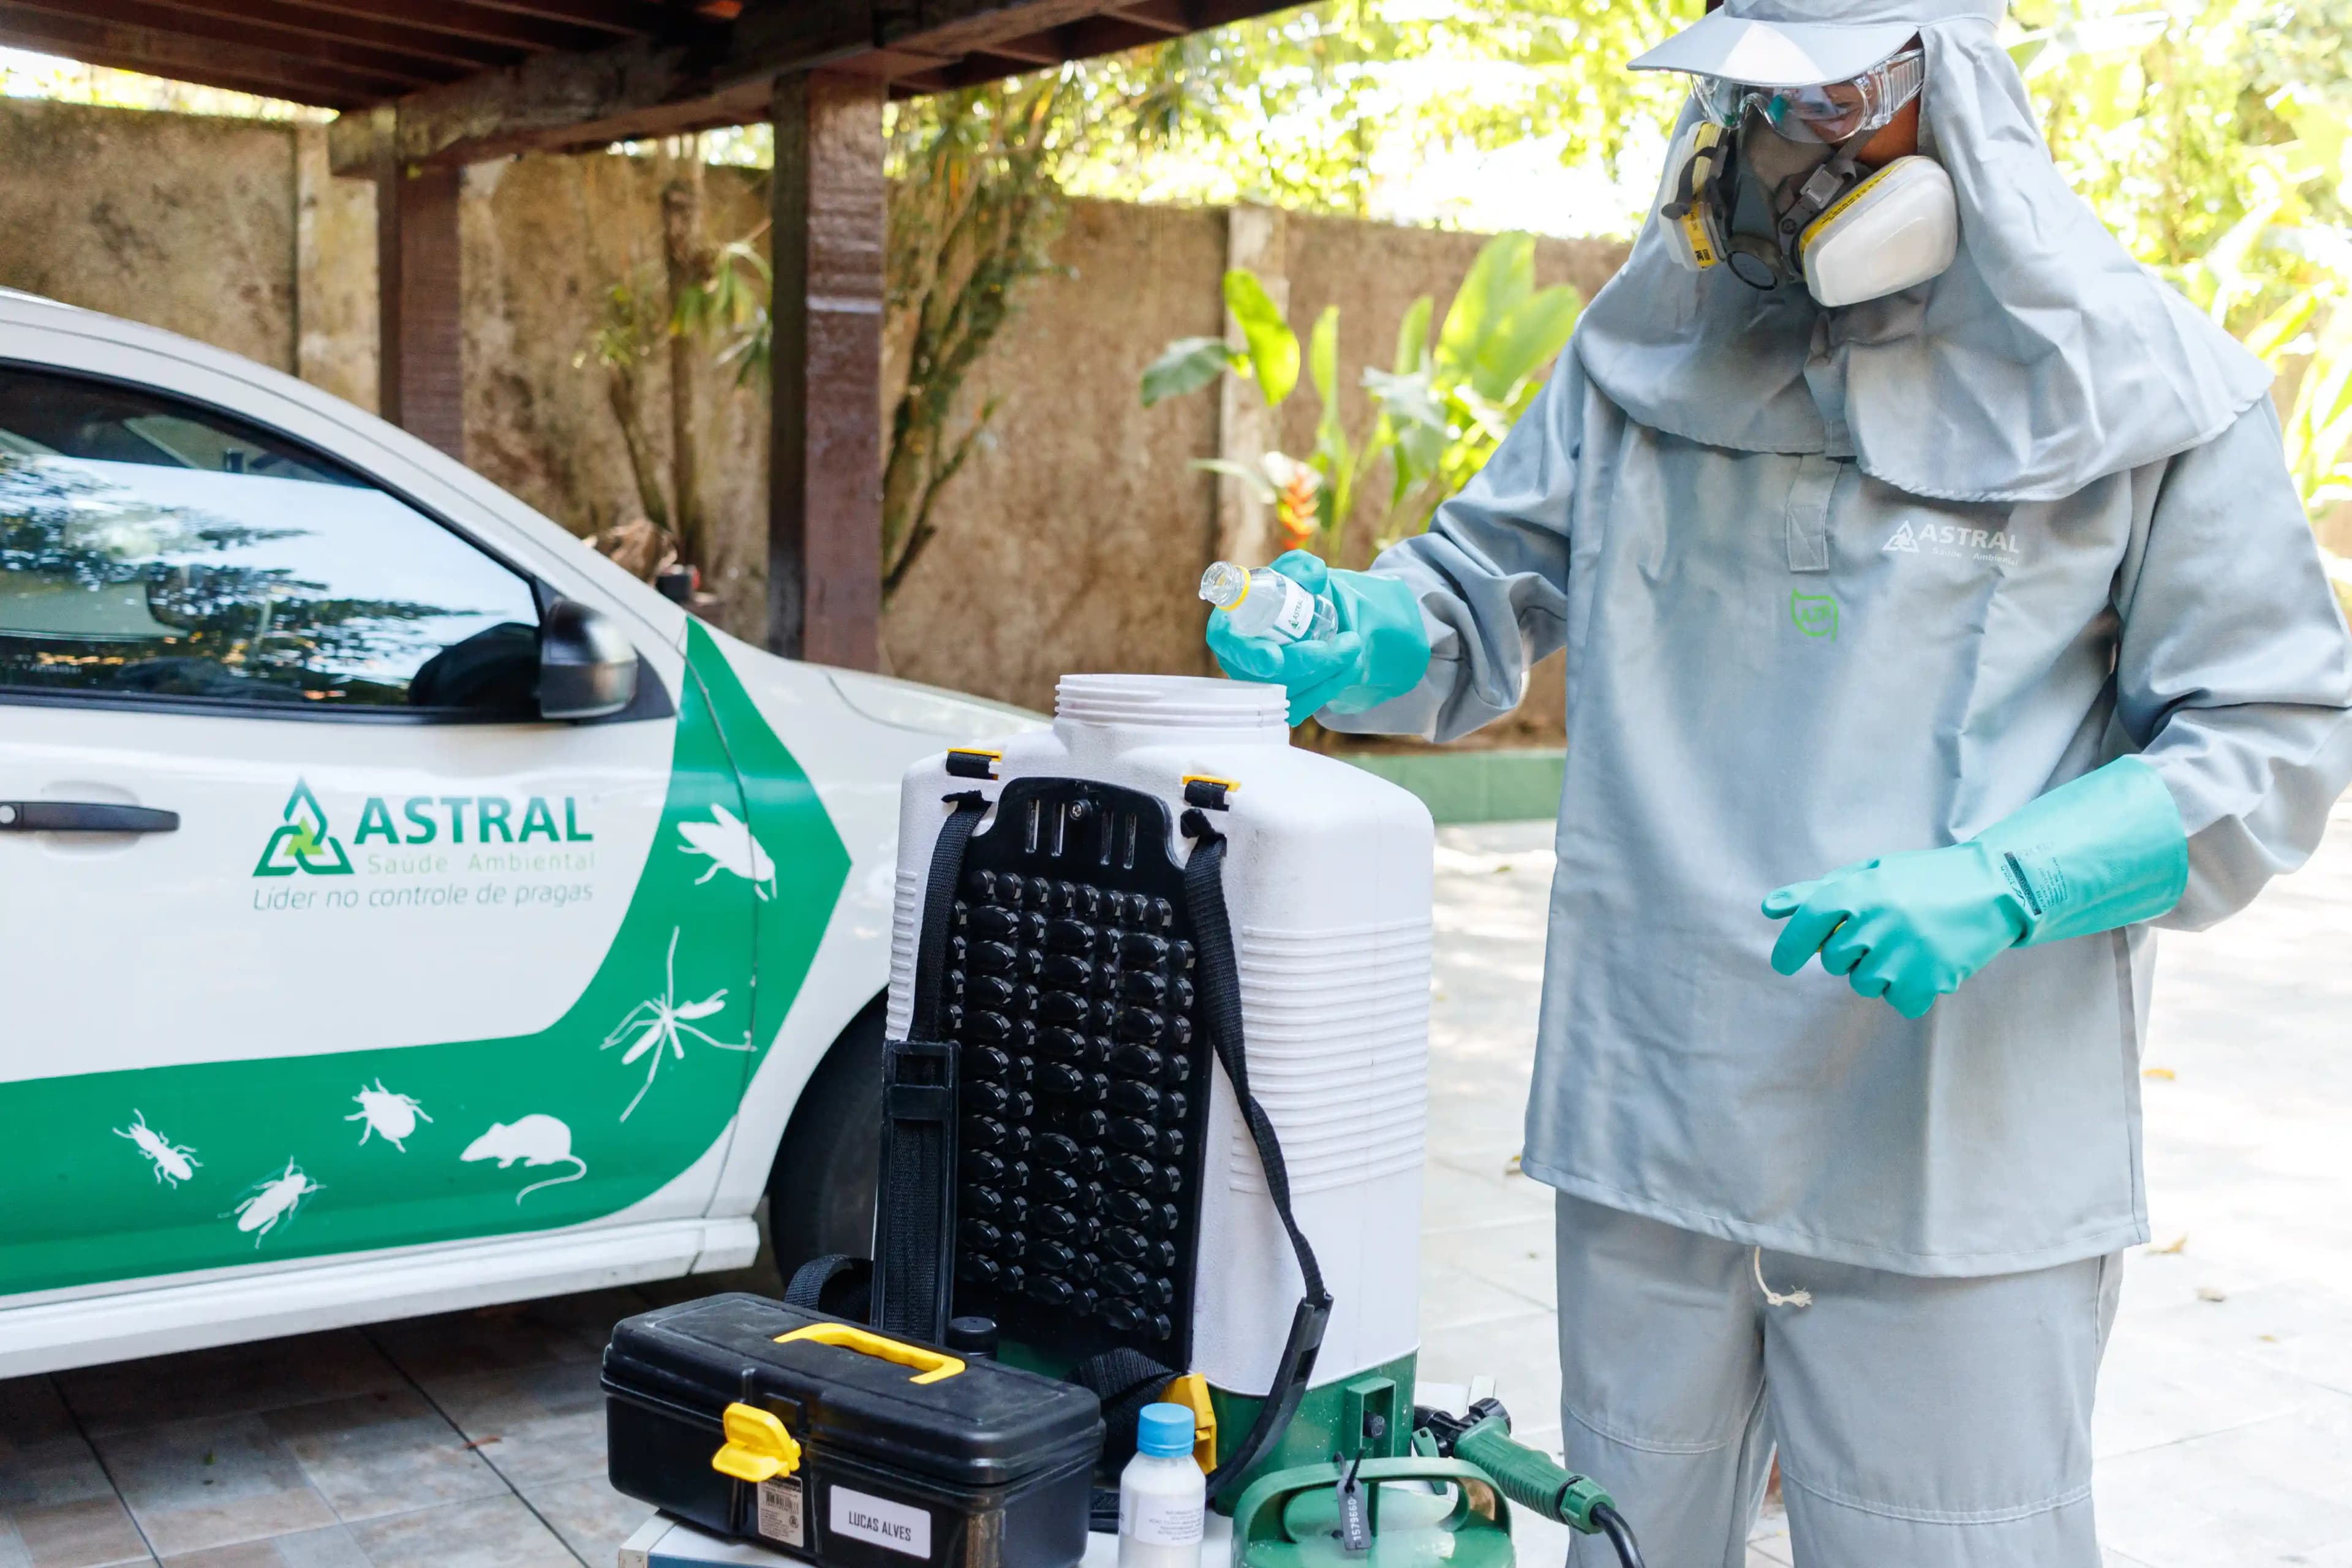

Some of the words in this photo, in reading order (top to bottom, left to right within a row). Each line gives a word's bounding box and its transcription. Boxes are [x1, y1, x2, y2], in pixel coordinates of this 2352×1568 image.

[1918, 524, 2019, 554] ASTRAL
[1973, 552, 2018, 567] Ambiental
[353, 796, 593, 845] ASTRAL
[368, 853, 448, 875] Saúde
[469, 851, 594, 872] Ambiental
[253, 886, 317, 910] Líder
[326, 889, 359, 908] no
[368, 883, 468, 908] controle
[476, 882, 507, 905] de
[514, 884, 594, 908] pragas
[849, 1510, 879, 1532] LUCAS
[881, 1521, 911, 1542] ALVES
[1348, 1498, 1362, 1541] 1579660
